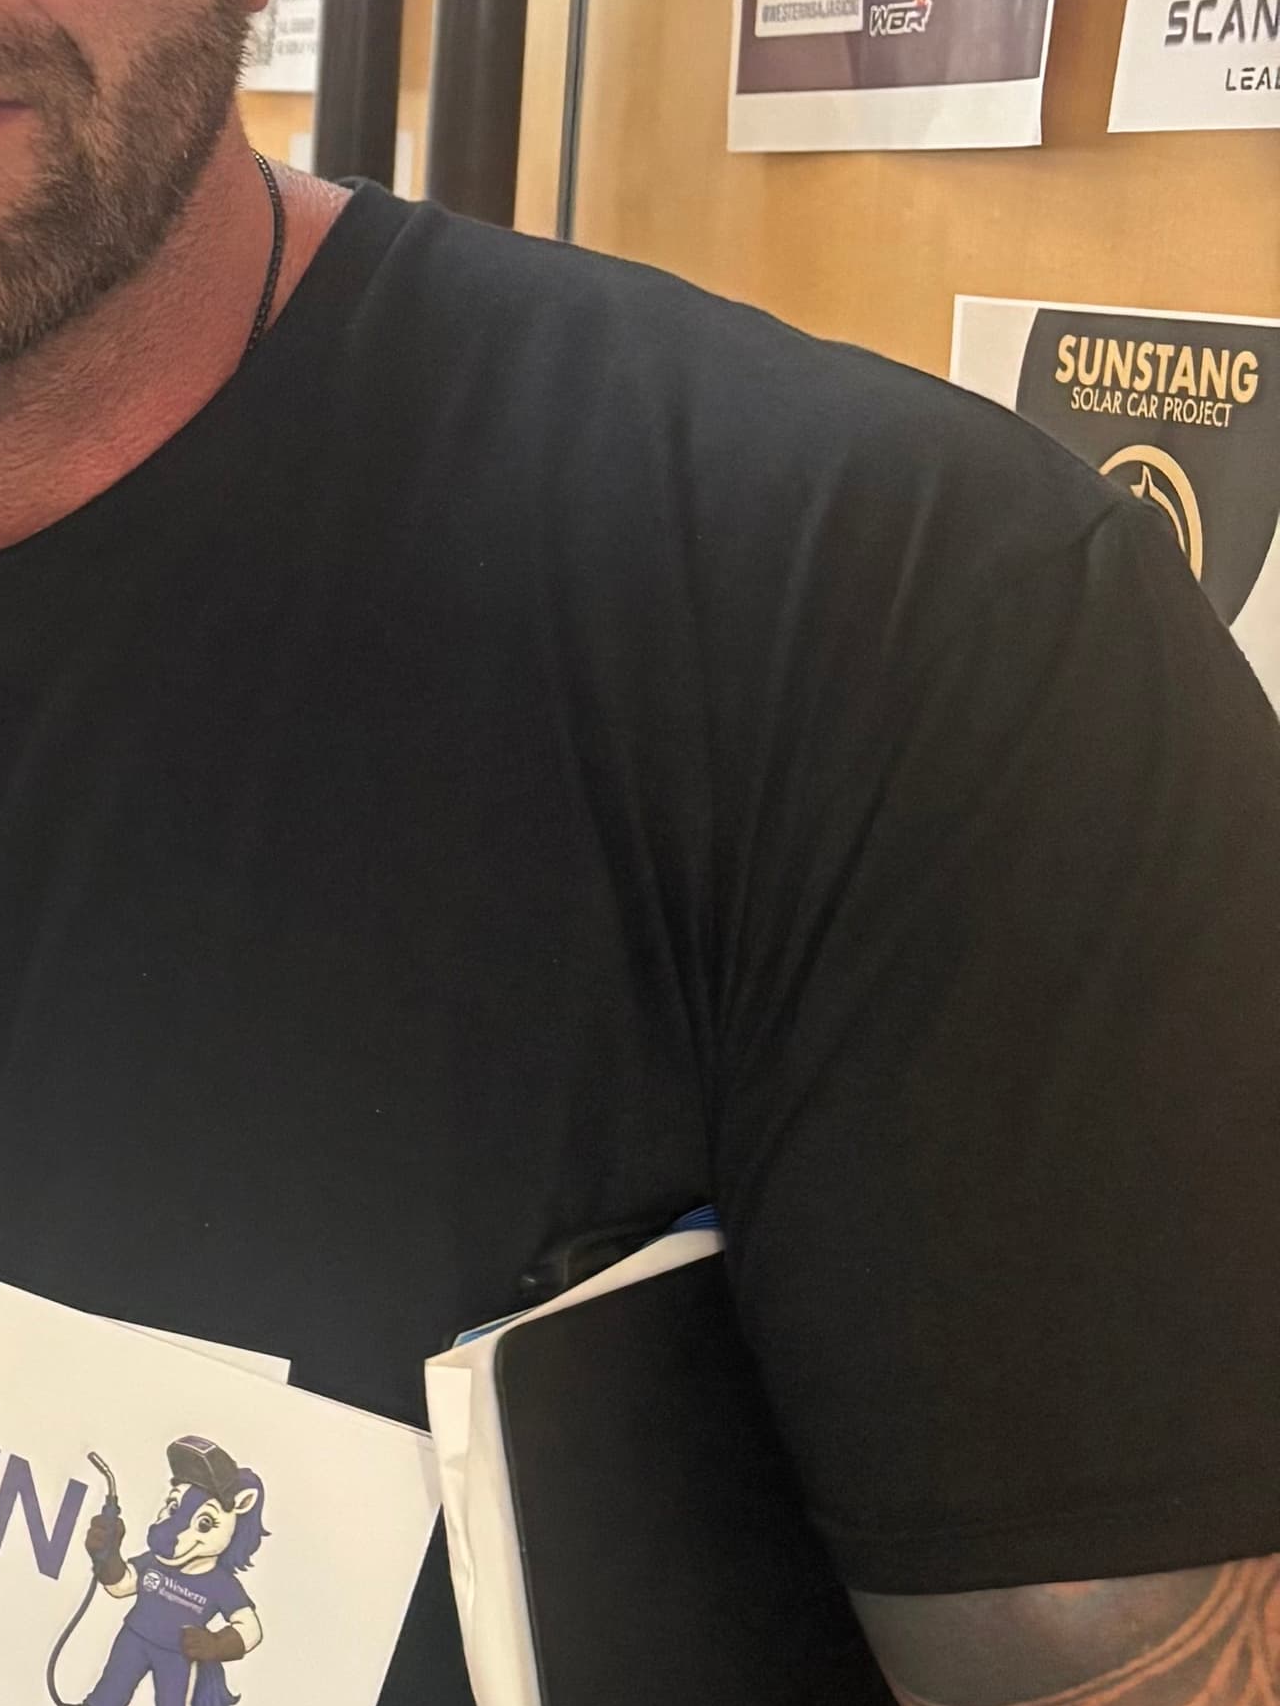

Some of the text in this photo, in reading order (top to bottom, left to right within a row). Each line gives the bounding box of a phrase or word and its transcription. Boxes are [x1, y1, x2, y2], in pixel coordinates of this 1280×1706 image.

[1055, 334, 1259, 404] SUNSTANG
[1070, 386, 1232, 429] SOLAR CAR PROJECT
